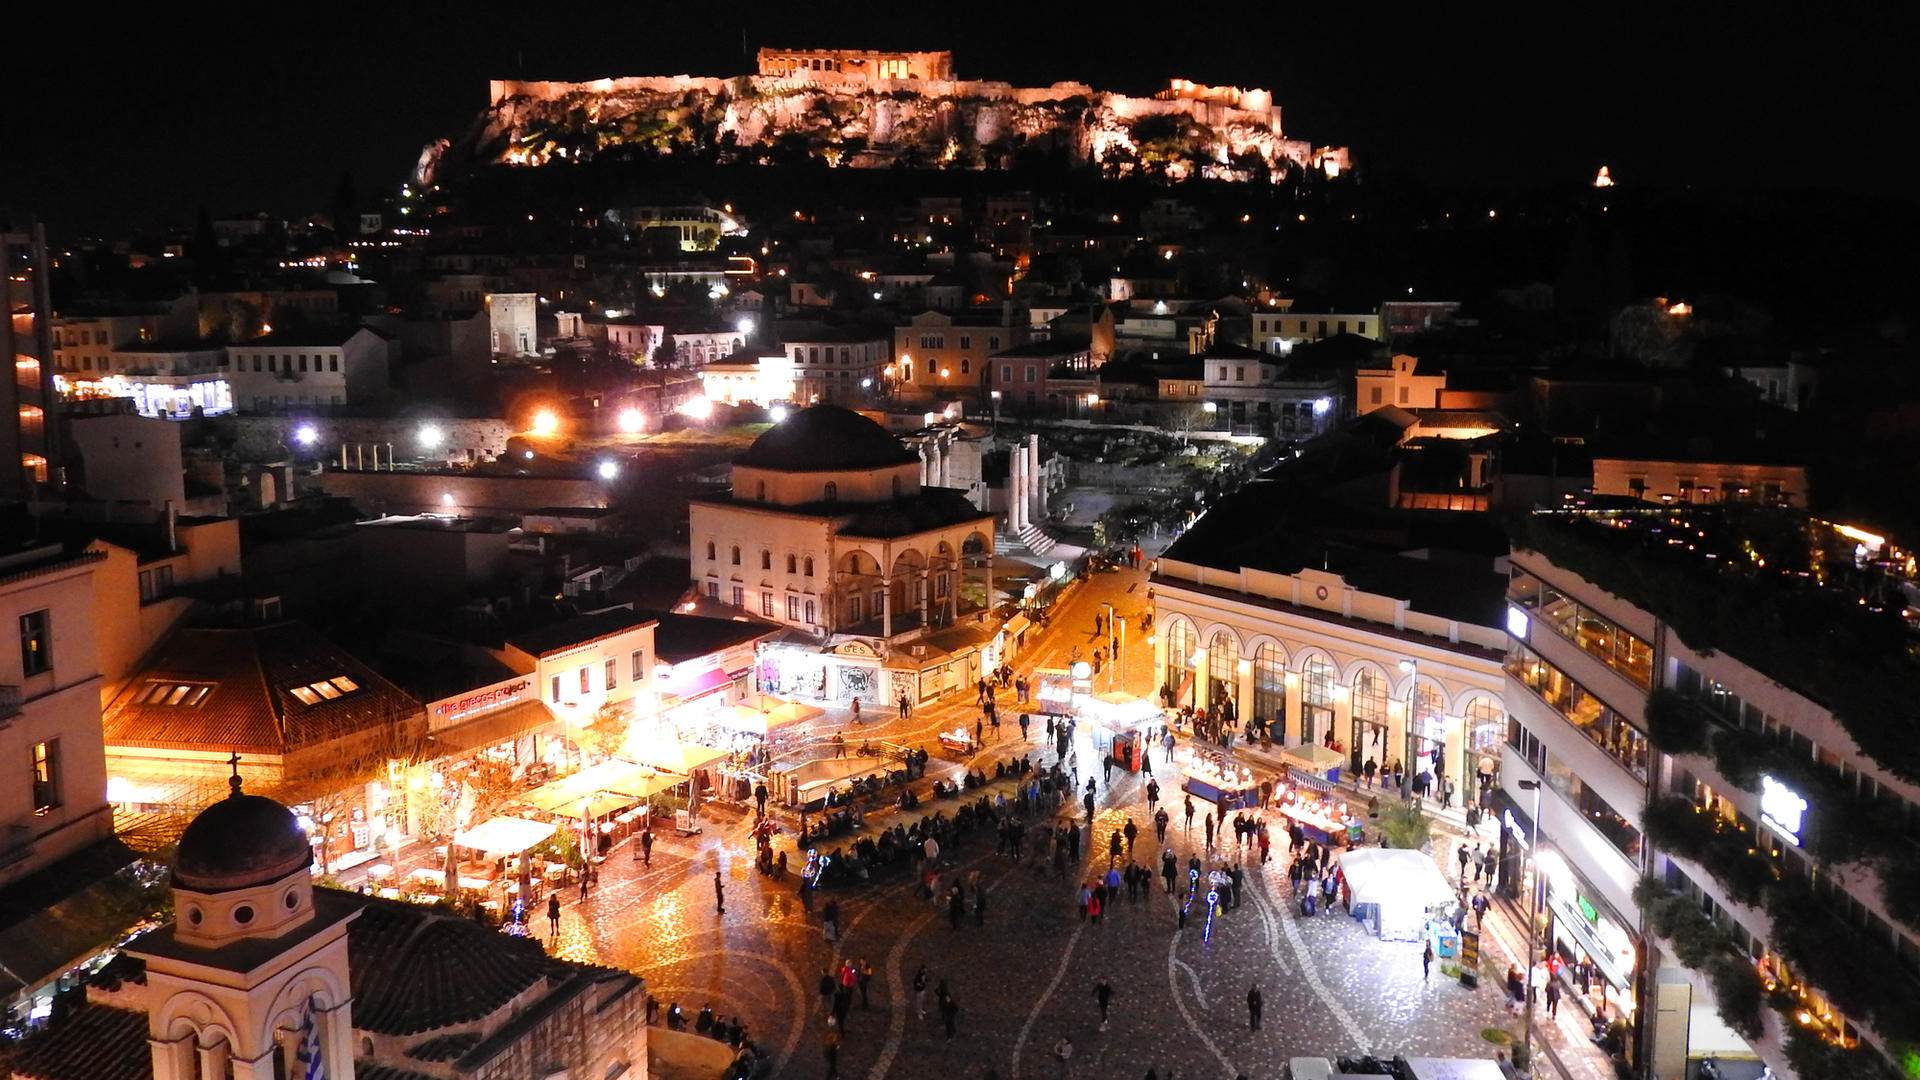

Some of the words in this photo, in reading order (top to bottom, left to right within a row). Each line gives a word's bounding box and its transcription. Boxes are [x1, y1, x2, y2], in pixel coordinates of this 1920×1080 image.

[441, 703, 458, 714] the
[460, 692, 495, 710] grecos
[495, 681, 526, 700] project
